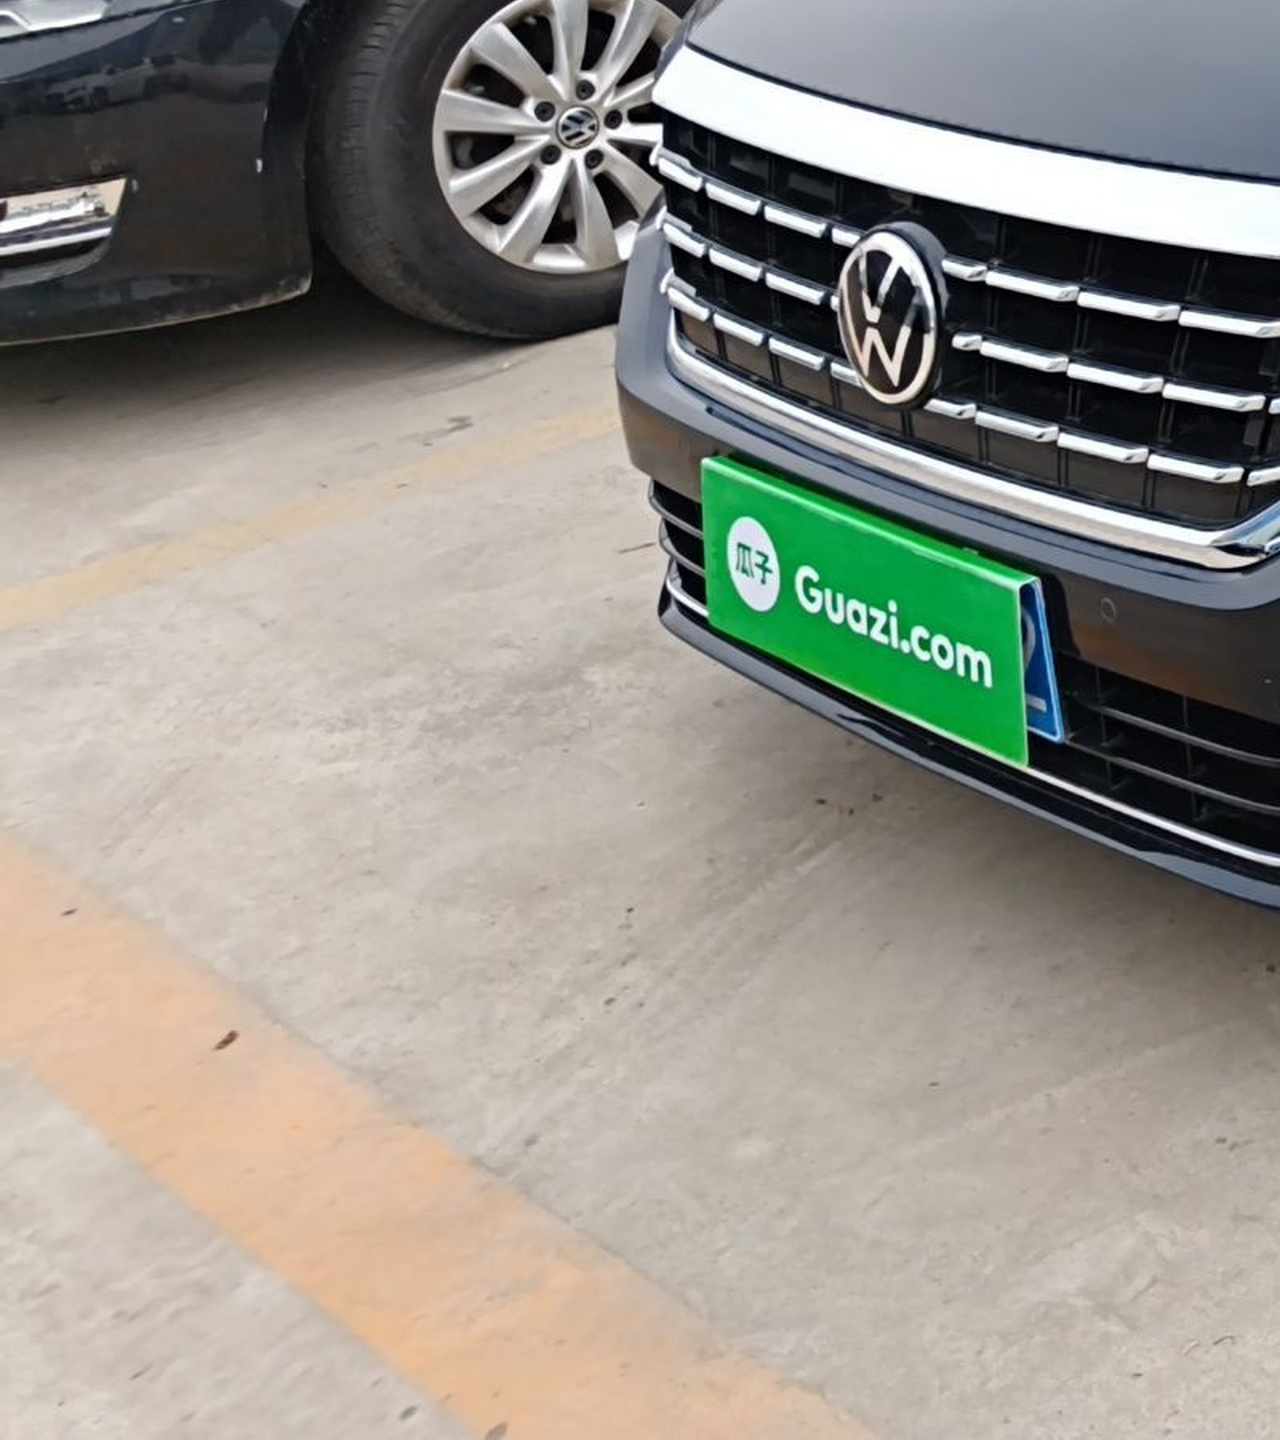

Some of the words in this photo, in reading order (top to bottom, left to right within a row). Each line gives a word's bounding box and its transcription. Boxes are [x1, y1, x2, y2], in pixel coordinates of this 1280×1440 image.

[838, 231, 937, 404] VW
[735, 541, 774, 586] 瓜子
[794, 564, 993, 689] Guazi.com
